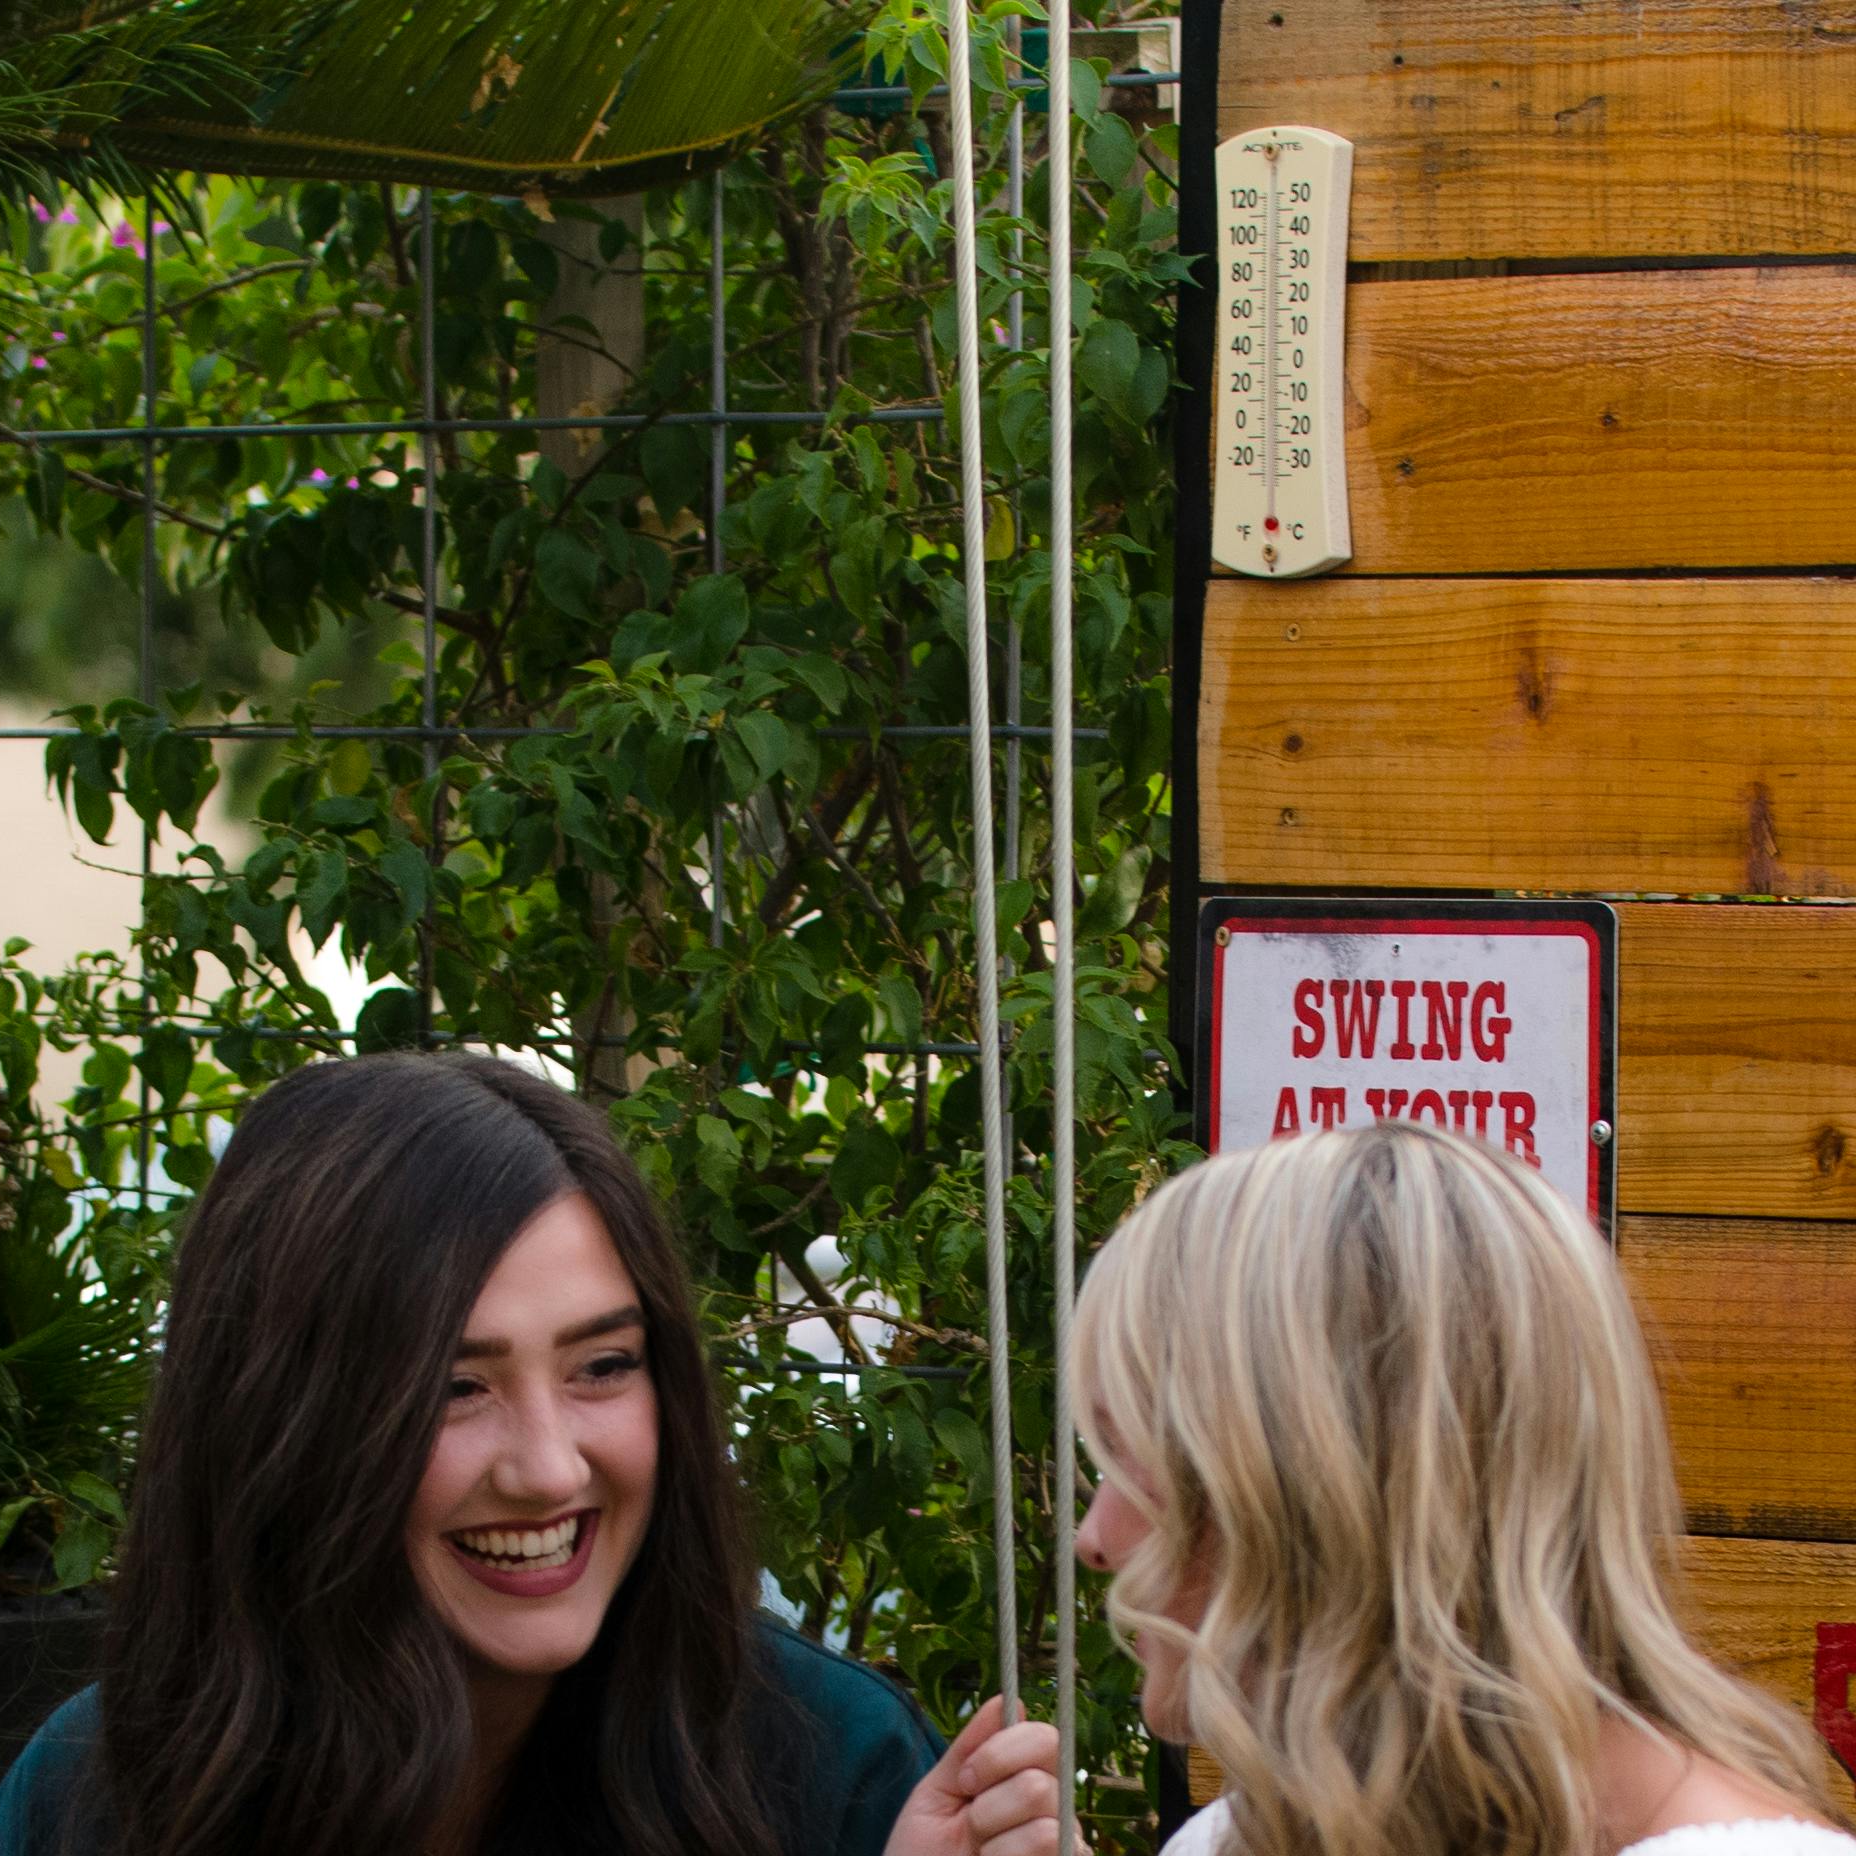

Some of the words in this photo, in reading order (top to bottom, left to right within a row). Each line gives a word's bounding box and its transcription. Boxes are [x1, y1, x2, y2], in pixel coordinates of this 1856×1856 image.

[1230, 189, 1257, 208] 120
[1290, 182, 1311, 202] 50
[1229, 225, 1257, 245] 100
[1289, 215, 1310, 235] 40
[1289, 249, 1310, 269] 30
[1231, 262, 1252, 282] 80
[1288, 282, 1309, 302] 20
[1230, 299, 1252, 319] 60
[1291, 315, 1308, 335] 10
[1231, 336, 1251, 355] 40
[1293, 348, 1303, 368] 0
[1231, 372, 1251, 392] 20
[1283, 382, 1308, 402] -10
[1235, 409, 1246, 429] 0
[1284, 415, 1310, 435] -20
[1228, 446, 1254, 466] -20
[1284, 449, 1310, 469] -30
[1292, 978, 1512, 1062] SWING
[1271, 1086, 1346, 1140] AT
